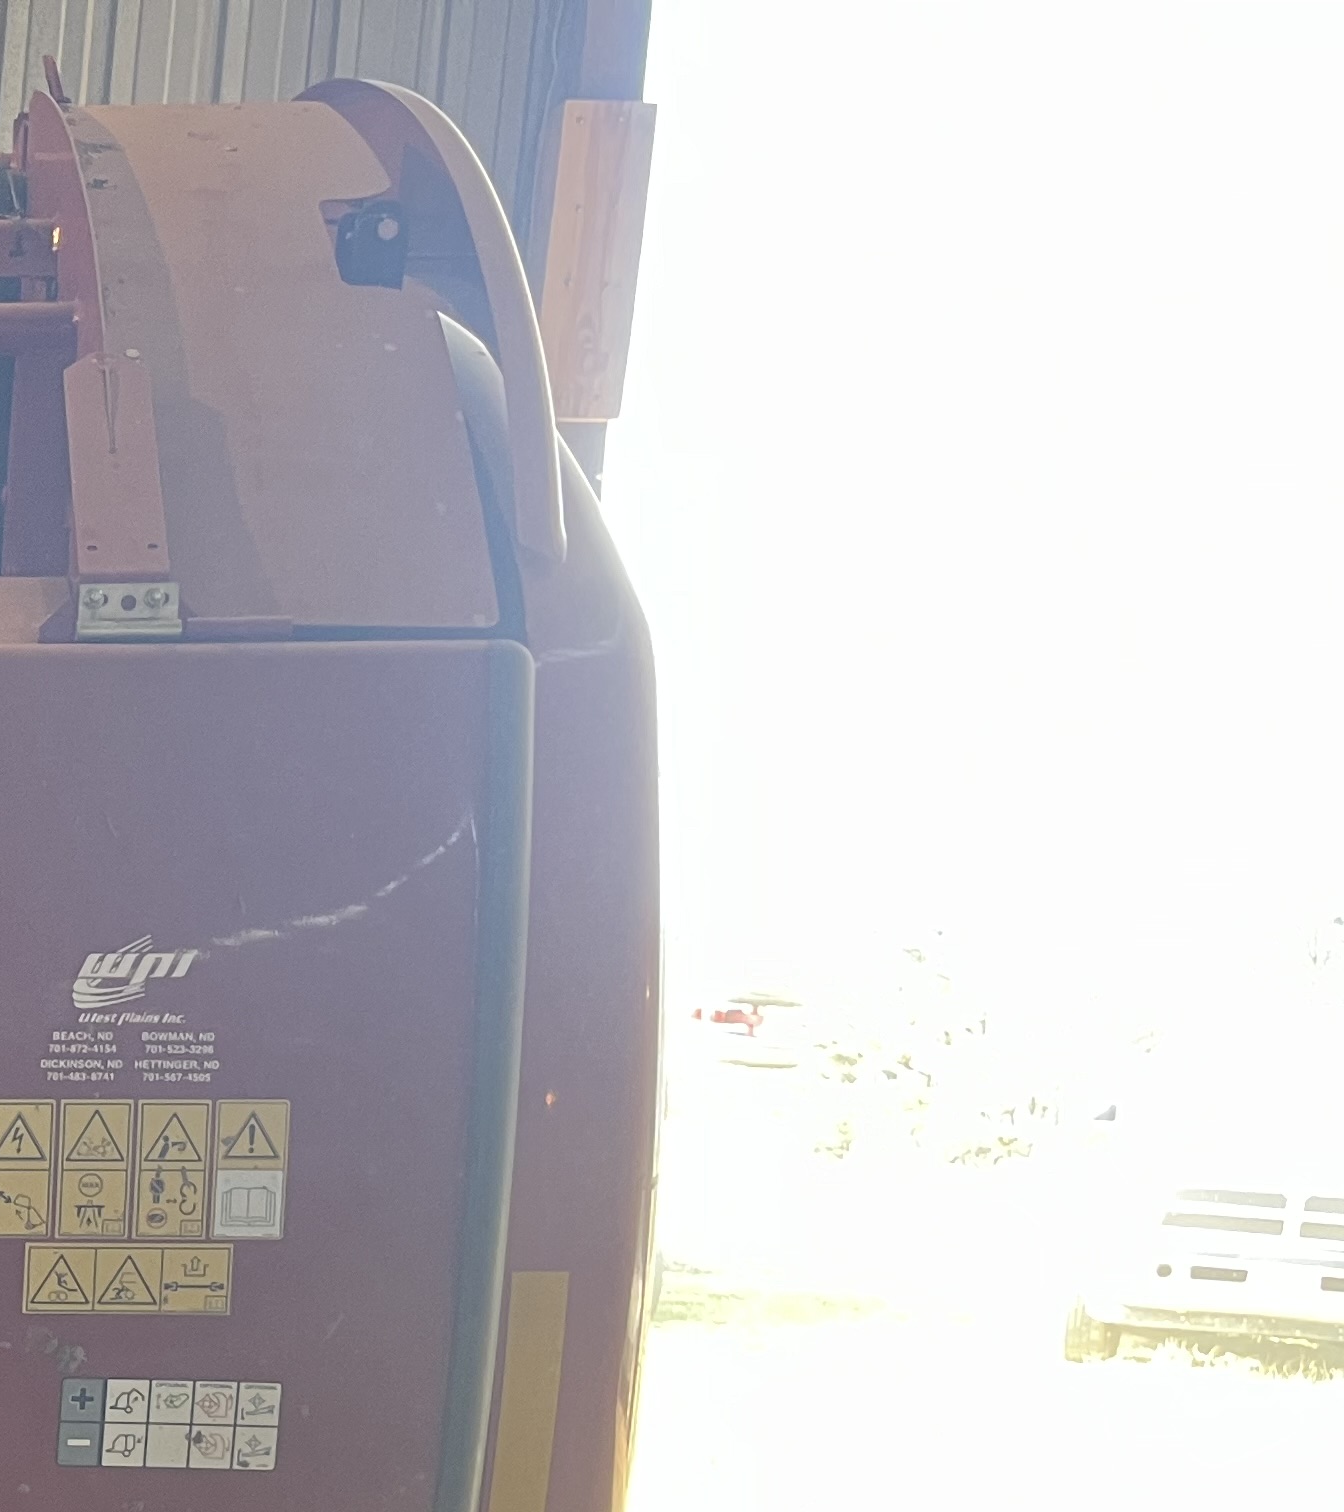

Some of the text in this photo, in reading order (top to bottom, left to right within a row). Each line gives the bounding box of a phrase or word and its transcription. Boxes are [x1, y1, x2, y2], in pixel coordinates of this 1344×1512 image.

[161, 1012, 187, 1024] Inc.
[52, 1031, 114, 1042] BEACH, ND
[141, 1031, 216, 1043] BOWMAN, ND
[40, 1059, 124, 1070] DICKINSON, ND
[134, 1060, 220, 1070] HETTINGER, ND
